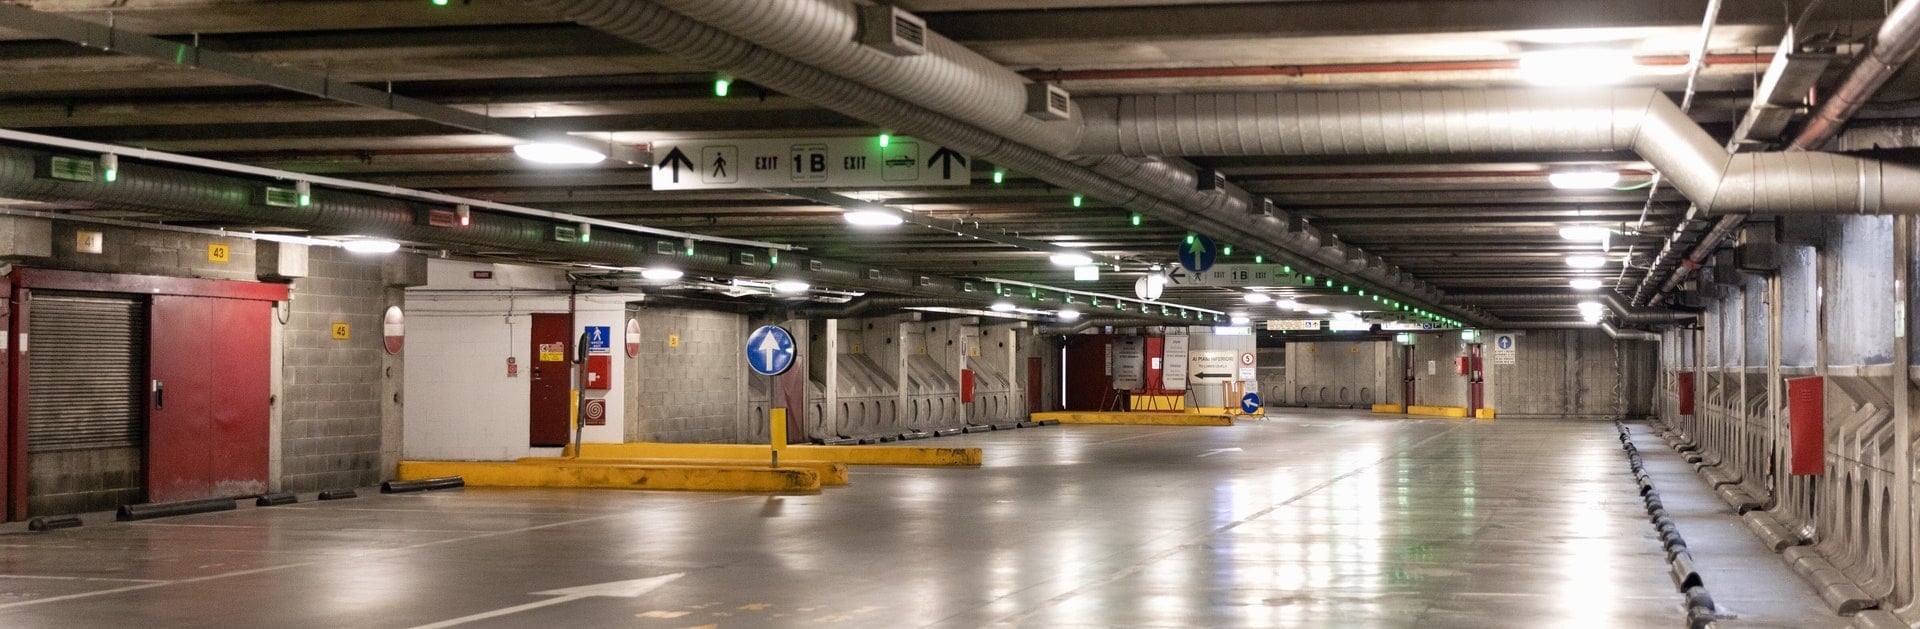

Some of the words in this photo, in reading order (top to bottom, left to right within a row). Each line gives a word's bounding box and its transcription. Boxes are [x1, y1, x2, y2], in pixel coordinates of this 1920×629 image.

[755, 156, 778, 170] EXIT
[844, 155, 866, 170] EXIT
[213, 247, 224, 259] 43
[336, 326, 346, 337] 45
